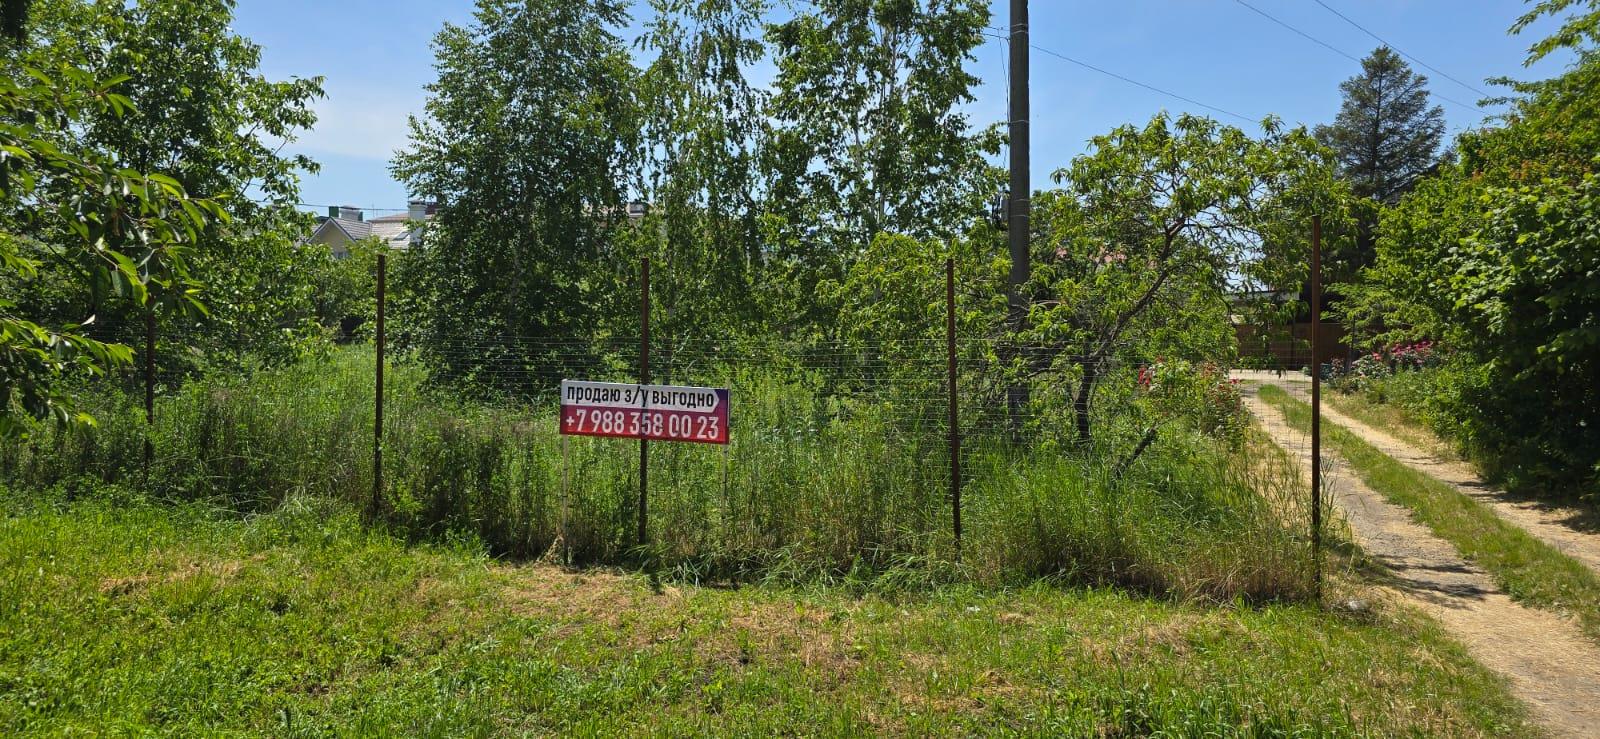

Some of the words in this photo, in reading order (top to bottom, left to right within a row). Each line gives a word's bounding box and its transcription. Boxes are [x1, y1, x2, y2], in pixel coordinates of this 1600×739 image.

[567, 386, 621, 403] продаю
[652, 390, 714, 408] выгодно
[566, 409, 587, 432] +7
[591, 410, 625, 433] 988
[629, 412, 664, 437] 358
[669, 414, 692, 438] 00
[697, 416, 719, 440] 23
